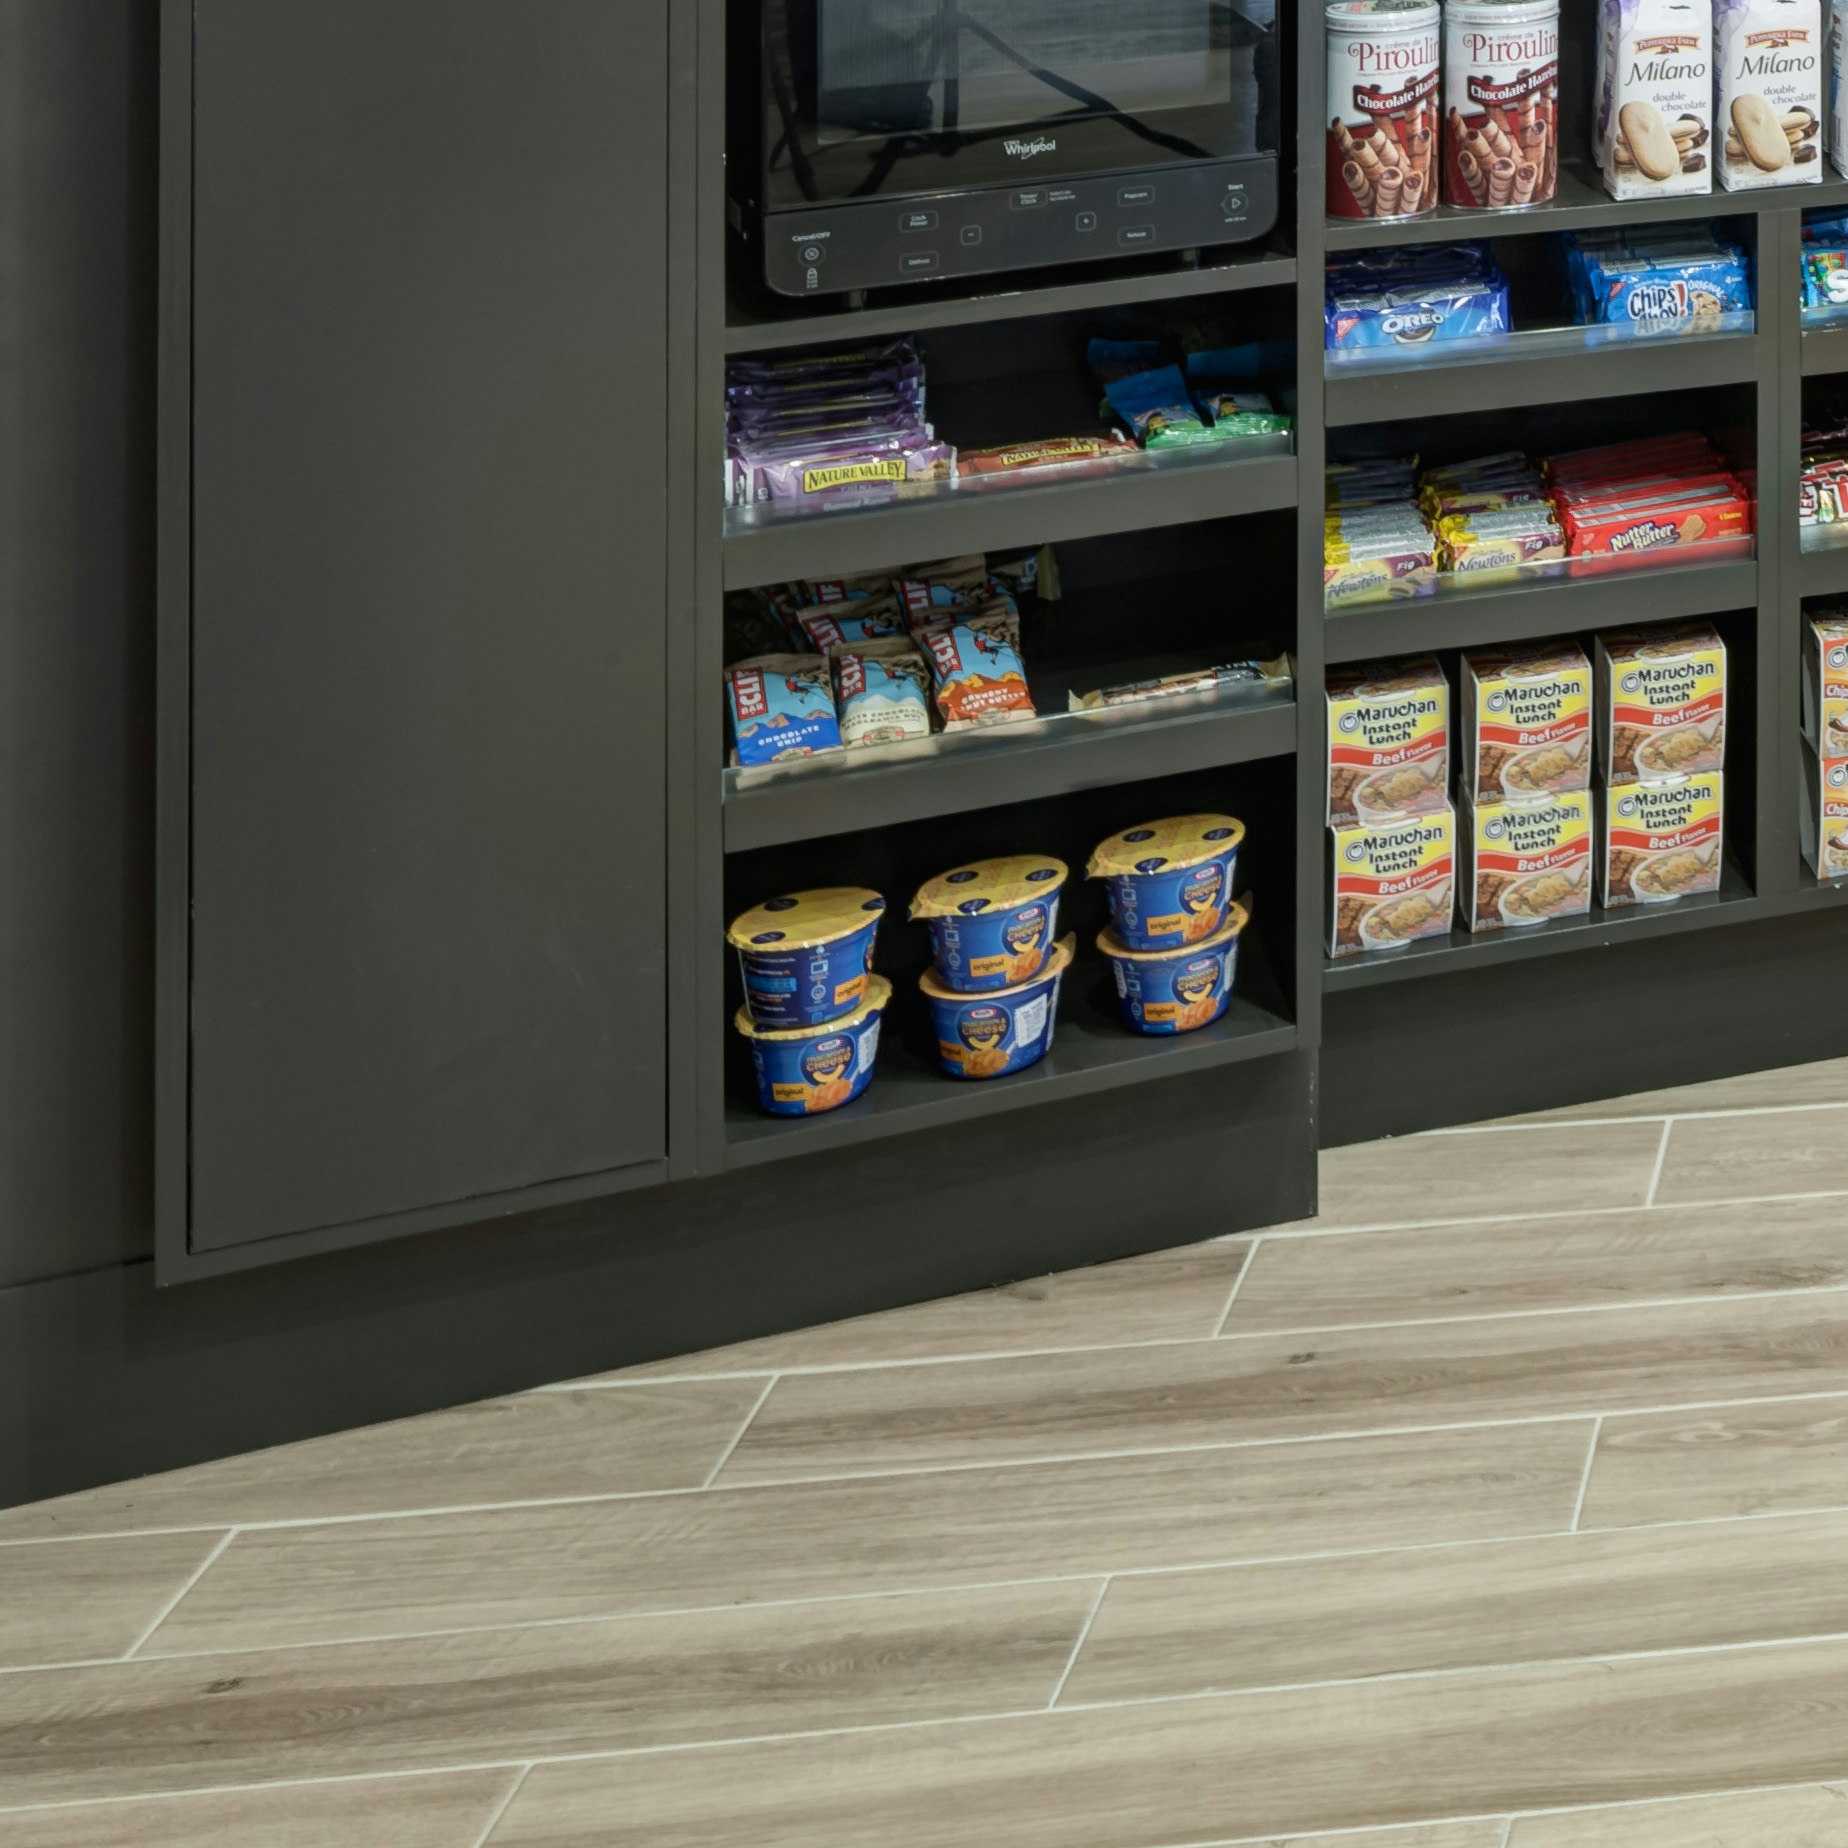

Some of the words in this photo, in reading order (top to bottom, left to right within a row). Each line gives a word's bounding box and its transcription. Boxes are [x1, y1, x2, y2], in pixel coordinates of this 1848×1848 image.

[1624, 58, 1706, 86] Milano
[1735, 52, 1815, 80] Milano
[1357, 88, 1414, 111] Chocolate
[1471, 80, 1527, 101] Chocolate
[1652, 92, 1686, 102] double
[1763, 85, 1796, 95] double
[1772, 92, 1817, 105] chocolate
[1661, 100, 1707, 112] chocolate
[1003, 138, 1056, 159] Whirlpool
[1629, 284, 1675, 317] Chips
[1381, 312, 1444, 334] OREO
[808, 467, 857, 491] NATURE
[859, 461, 905, 481] VALLEY
[1525, 539, 1544, 551] Fig
[1610, 522, 1655, 551] Nutter
[1633, 524, 1675, 550] Butter
[1396, 559, 1415, 571] Fig
[1458, 550, 1516, 572] Newtons
[1327, 572, 1388, 599] Newtons
[738, 670, 762, 707] CLIF
[741, 703, 764, 715] BAR
[1357, 699, 1438, 724] Maruchan
[758, 725, 820, 745] CHOCOLATE
[1363, 719, 1417, 735] Instant
[777, 736, 803, 747] CHIP
[1369, 731, 1411, 745] Lunch
[1372, 751, 1407, 767] Beef
[1363, 826, 1443, 852] Maruchan
[1369, 846, 1424, 864] Instant
[1375, 858, 1417, 874] Lunch
[1379, 878, 1413, 895] Beef
[973, 959, 1006, 972] original
[775, 1087, 805, 1097] original
